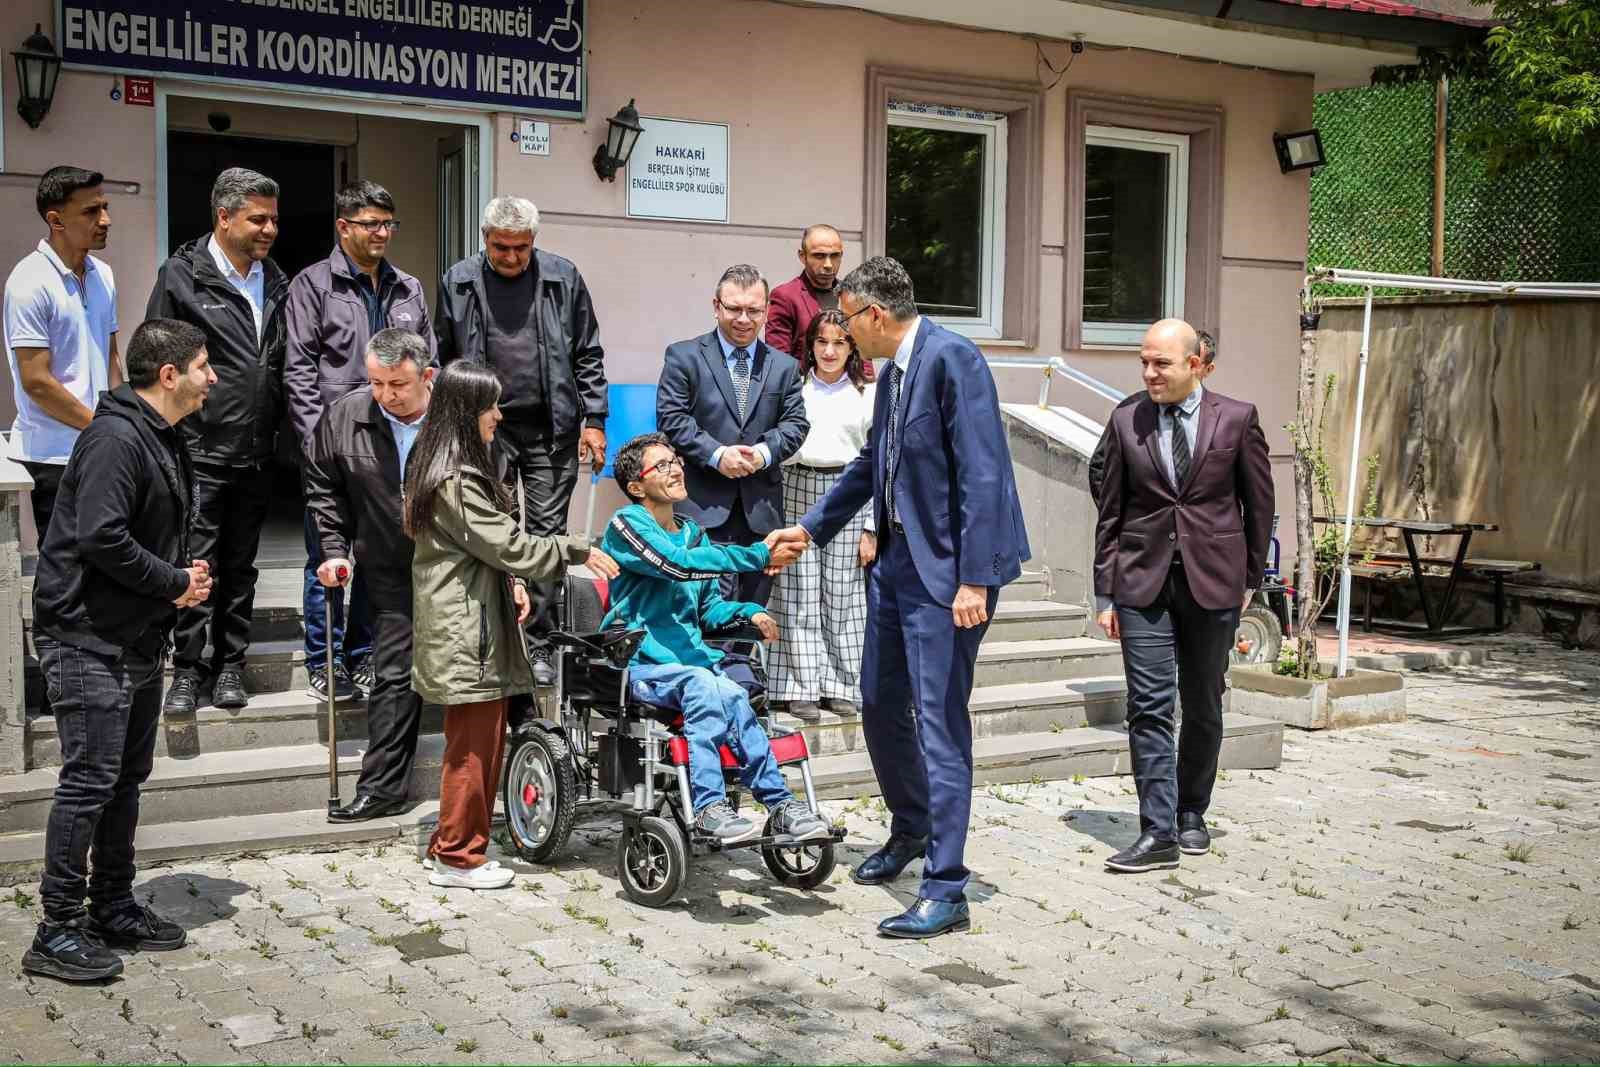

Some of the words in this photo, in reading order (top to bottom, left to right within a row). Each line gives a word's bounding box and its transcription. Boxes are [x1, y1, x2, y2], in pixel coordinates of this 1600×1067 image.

[459, 5, 533, 38] DERNEĞİ
[65, 7, 249, 67] ENGELLİLER
[257, 29, 468, 89] KOORDİNASYON
[476, 54, 581, 101] MERKEZİ
[529, 122, 536, 134] 1
[656, 145, 705, 160] HAKKARİ
[648, 163, 684, 176] BERÇELAN
[686, 164, 711, 178] İŞİTME
[632, 178, 674, 191] ENGELLİLER
[675, 181, 695, 192] SPOR
[696, 182, 725, 194] KULÜBÜ
